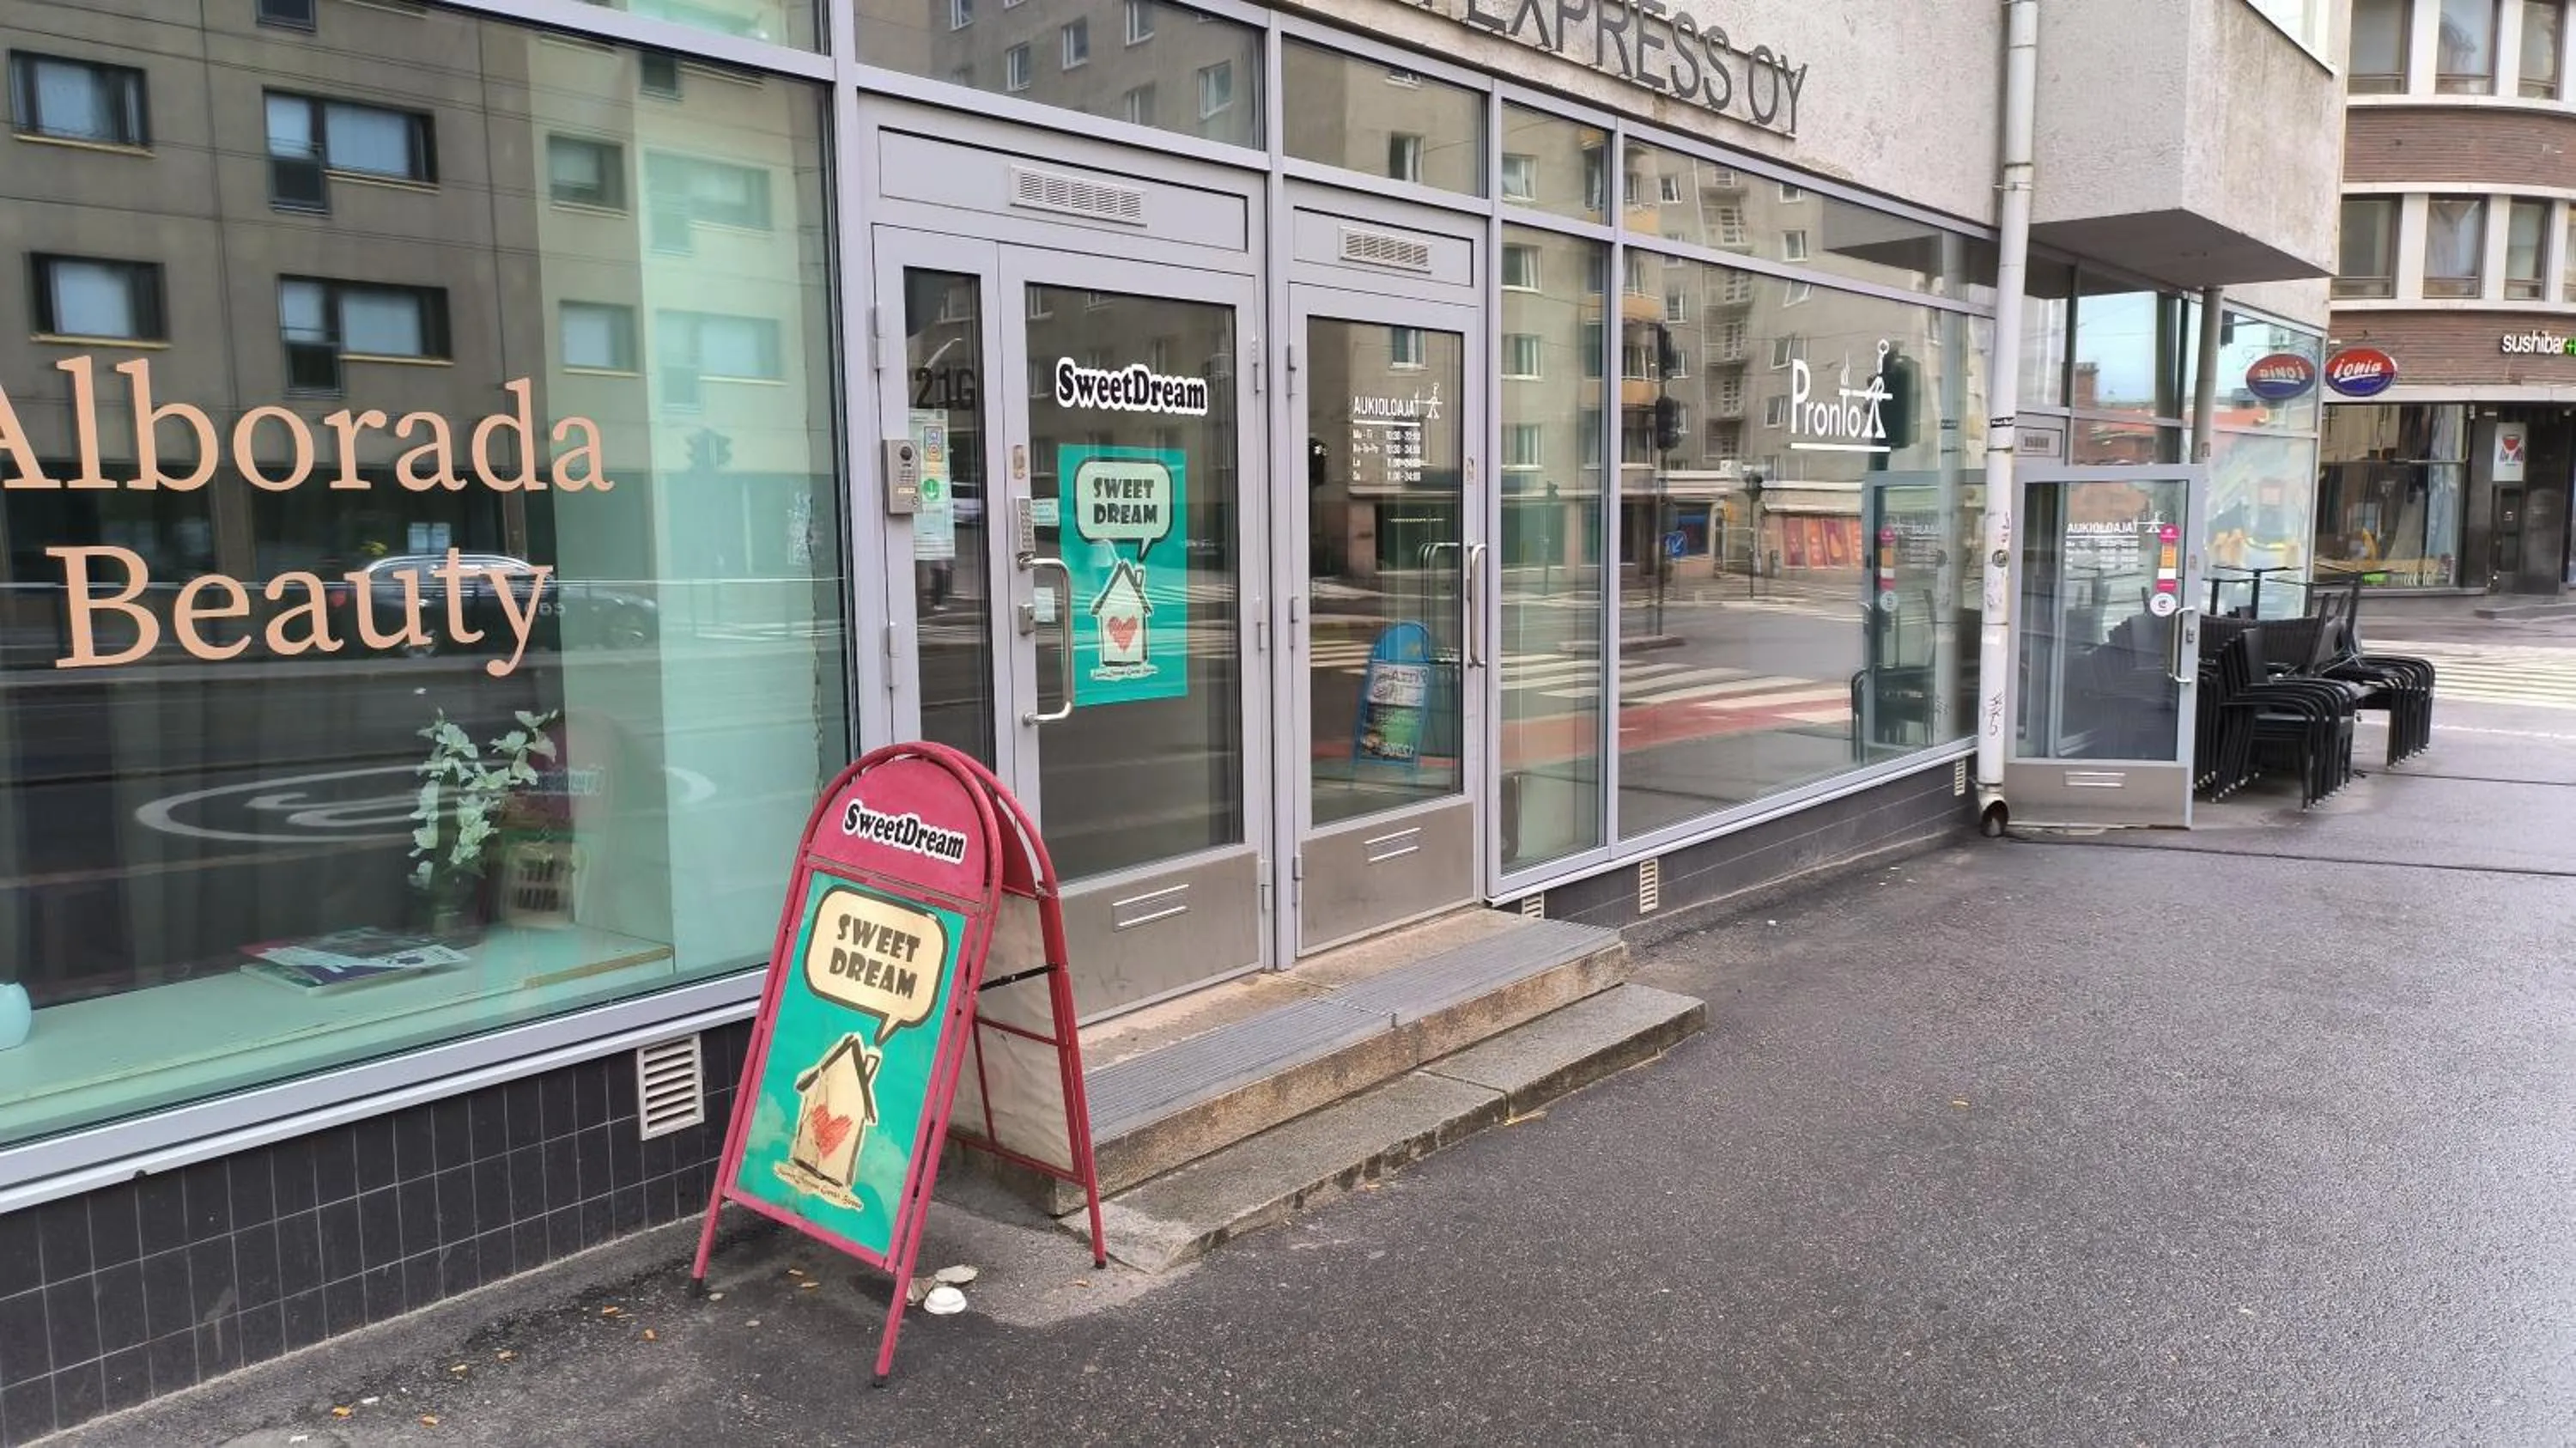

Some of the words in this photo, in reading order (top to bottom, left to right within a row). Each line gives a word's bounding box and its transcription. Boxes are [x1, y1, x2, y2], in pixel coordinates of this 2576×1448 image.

[1747, 44, 1808, 135] OY
[1058, 361, 1206, 412] SweetDream
[1790, 358, 1862, 438] Pronto
[0, 356, 614, 492] Alborada
[1093, 478, 1155, 498] SWEET
[1093, 503, 1157, 524] DREAM
[46, 545, 554, 678] Beauty
[843, 801, 965, 861] SweetDream
[837, 913, 921, 963] SWEET
[829, 946, 918, 999] DREAM
